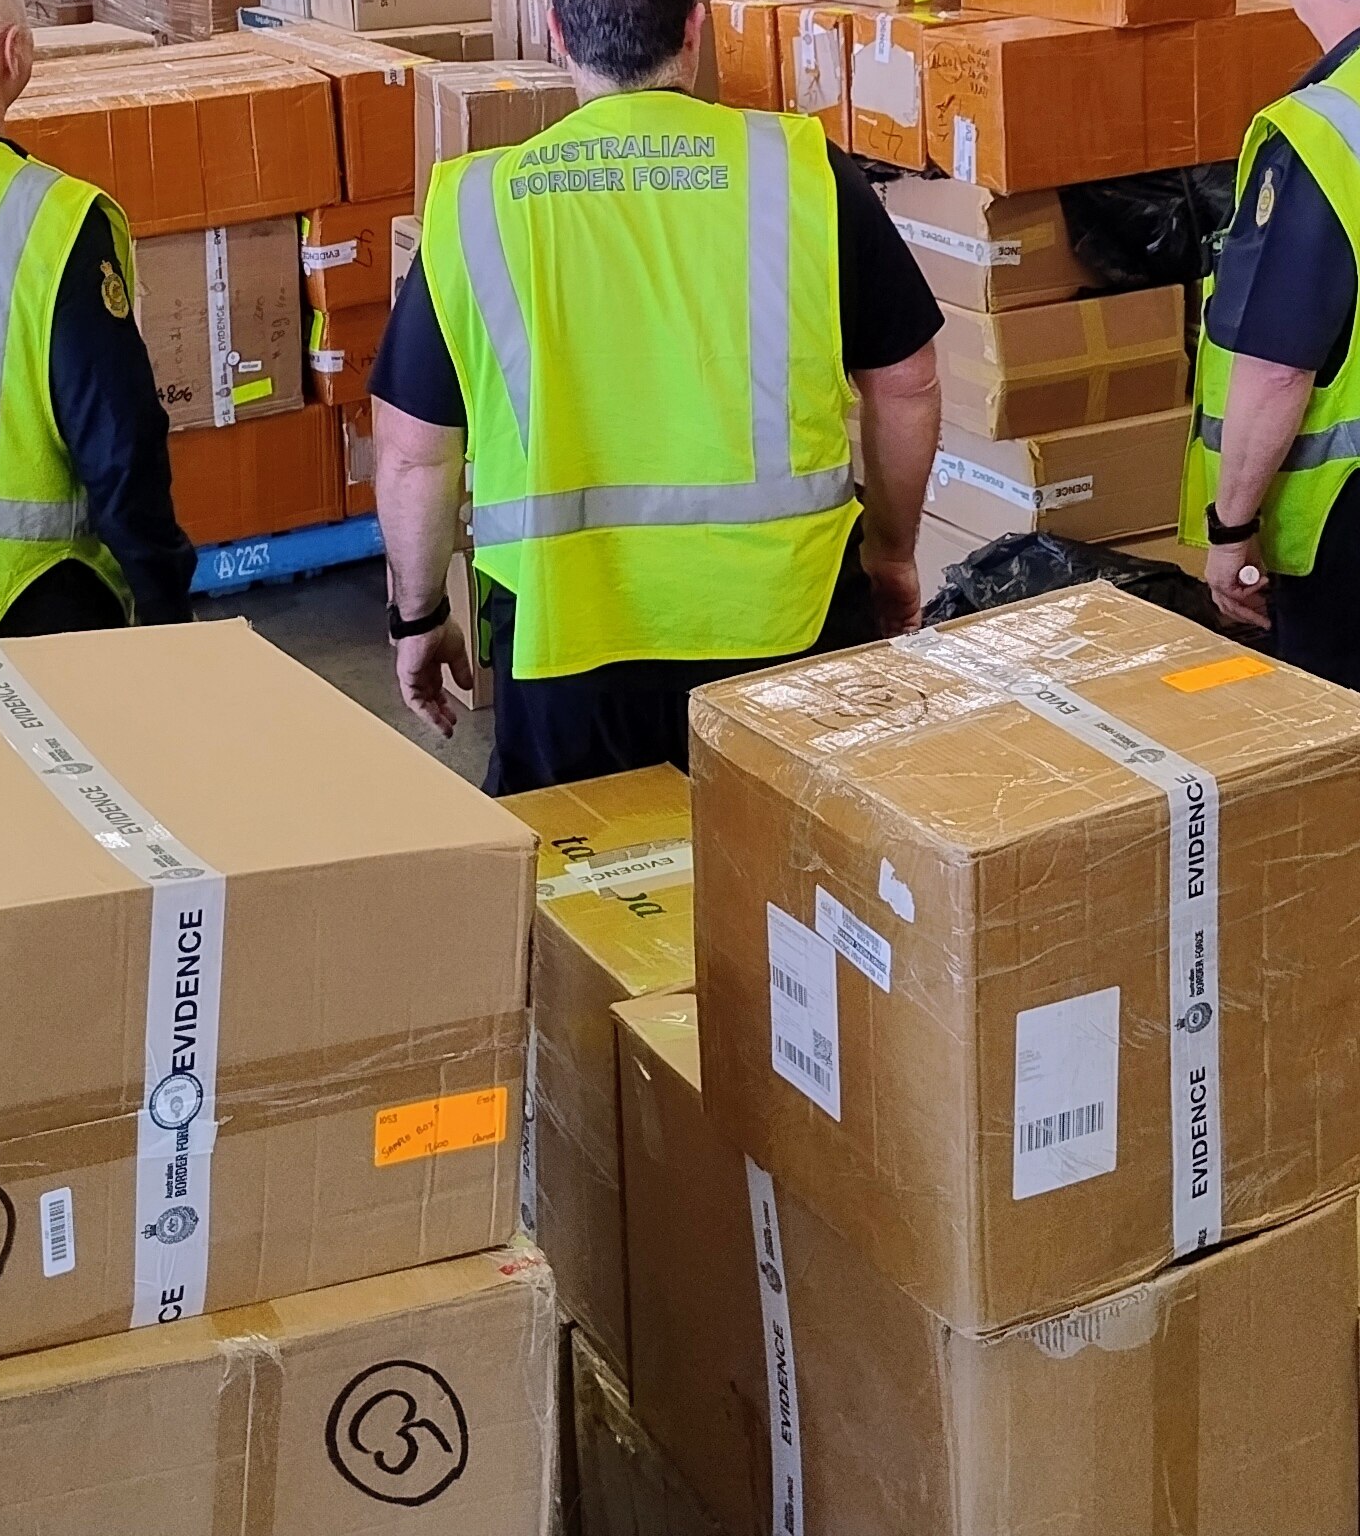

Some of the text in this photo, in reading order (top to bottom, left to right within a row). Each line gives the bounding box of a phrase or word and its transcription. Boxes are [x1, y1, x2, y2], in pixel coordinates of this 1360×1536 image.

[518, 135, 715, 170] AUSTRALIAN
[510, 165, 729, 200] BORDER FORCE
[217, 304, 227, 353] EVIDENCE
[79, 784, 144, 836] EVIDENCE
[1175, 772, 1205, 901] EVIDENCE
[577, 856, 675, 885] EVIDENCE
[1196, 928, 1205, 996] BORDER FORCE
[172, 907, 204, 1076] EVIDENCE
[416, 1119, 435, 1135] BOX
[1190, 1065, 1208, 1200] EVIDENCE
[175, 1154, 190, 1197] BORDER
[773, 1320, 792, 1446] EVIDENCE
